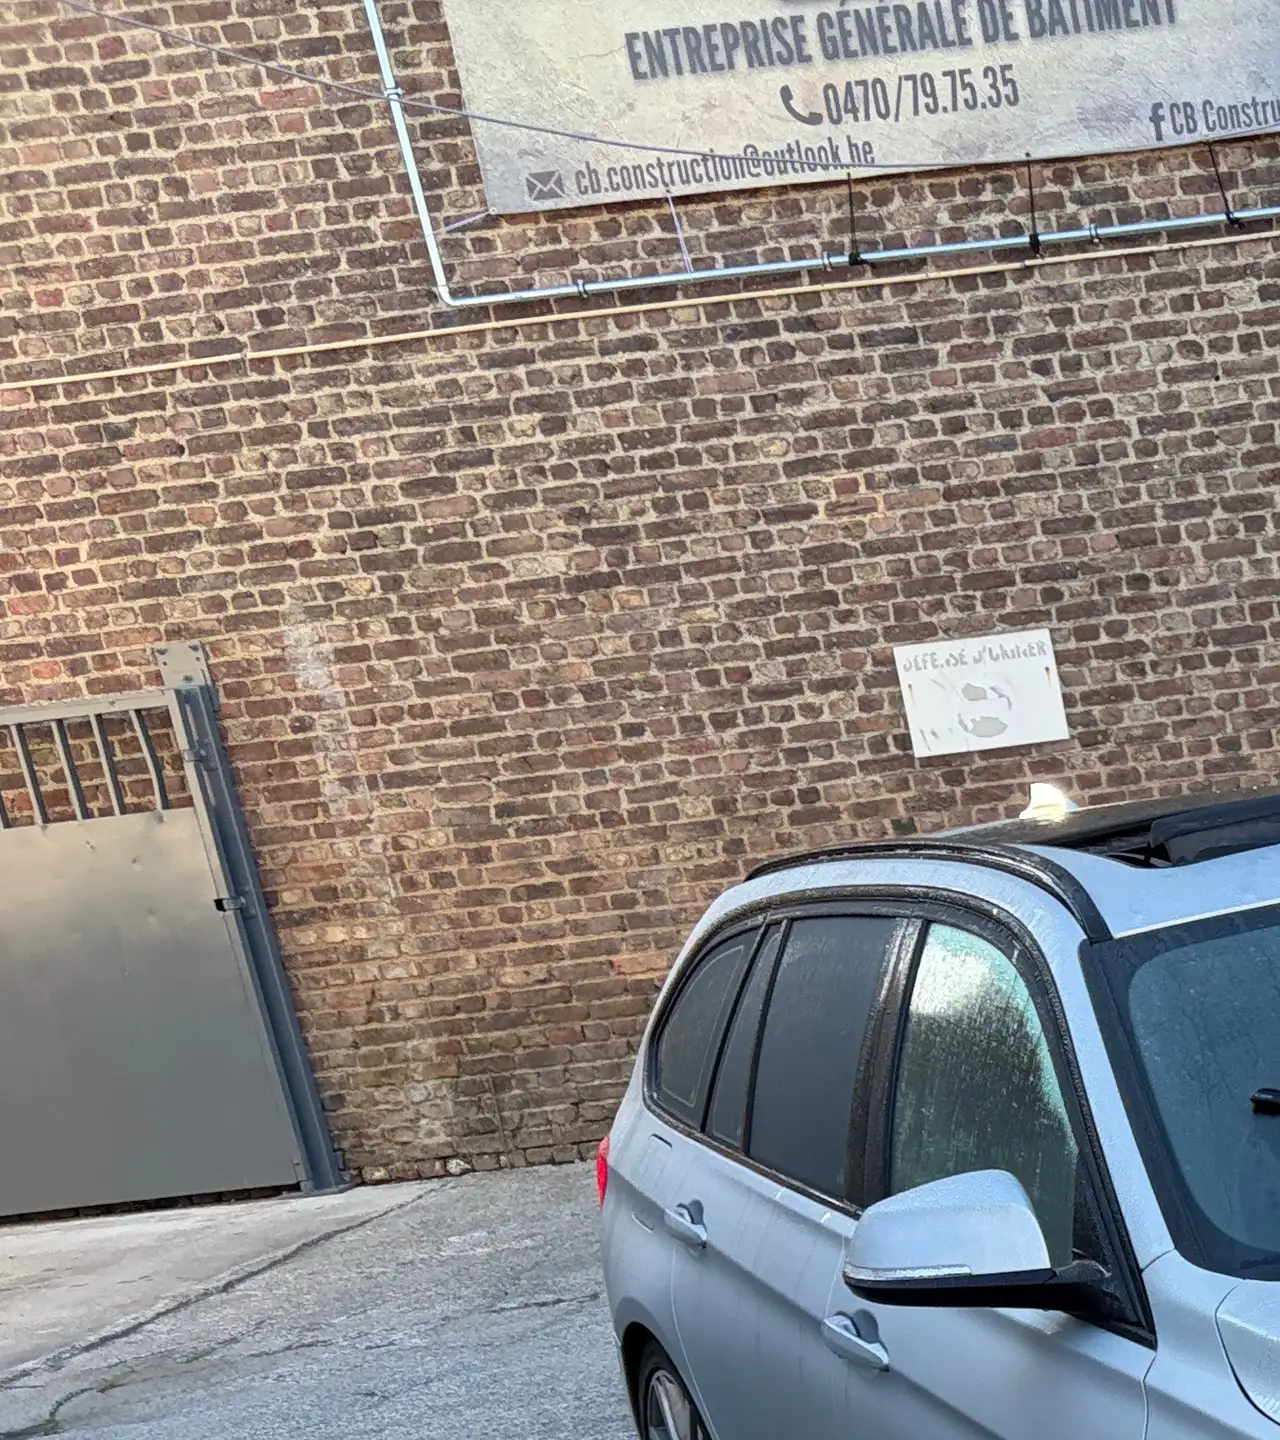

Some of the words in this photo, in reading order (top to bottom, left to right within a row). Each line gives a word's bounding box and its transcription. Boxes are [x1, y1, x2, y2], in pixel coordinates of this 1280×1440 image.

[625, 15, 812, 81] ENTREPRISE
[978, 0, 1019, 43] DE
[822, 64, 1020, 126] 0470/79.75.35
[1169, 101, 1198, 136] CB
